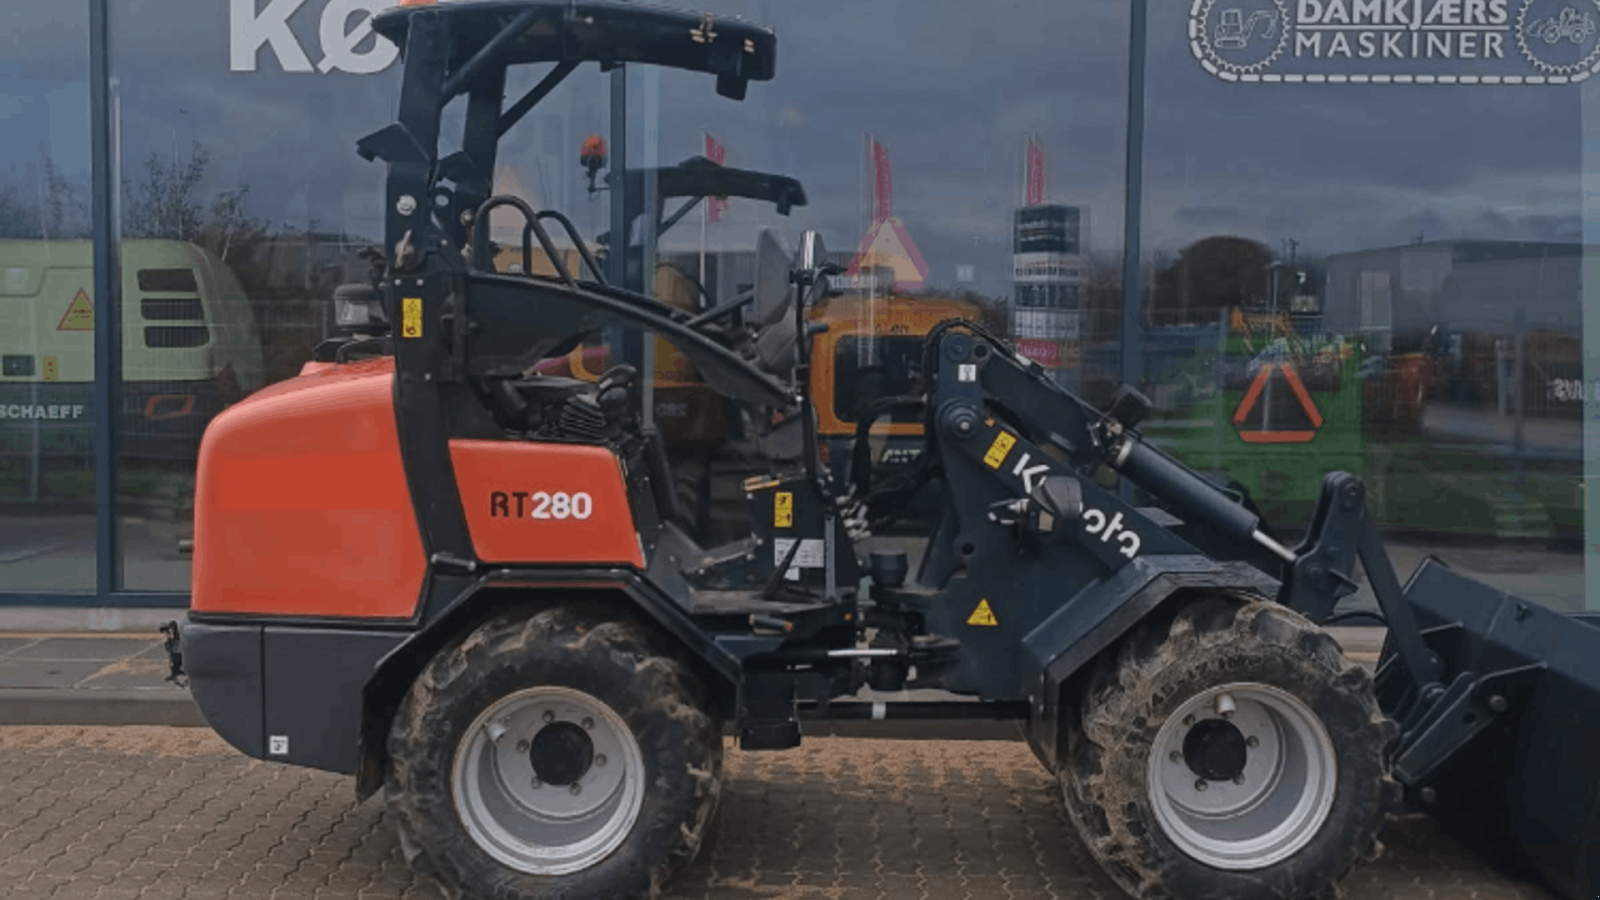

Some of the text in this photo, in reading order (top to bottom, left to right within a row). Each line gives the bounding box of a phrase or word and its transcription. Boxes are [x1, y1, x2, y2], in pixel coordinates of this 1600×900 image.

[1297, 0, 1508, 30] DAMKJÆRS
[1295, 31, 1505, 58] MASKINER
[490, 491, 592, 519] RT280
[1012, 452, 1141, 558] Kota
